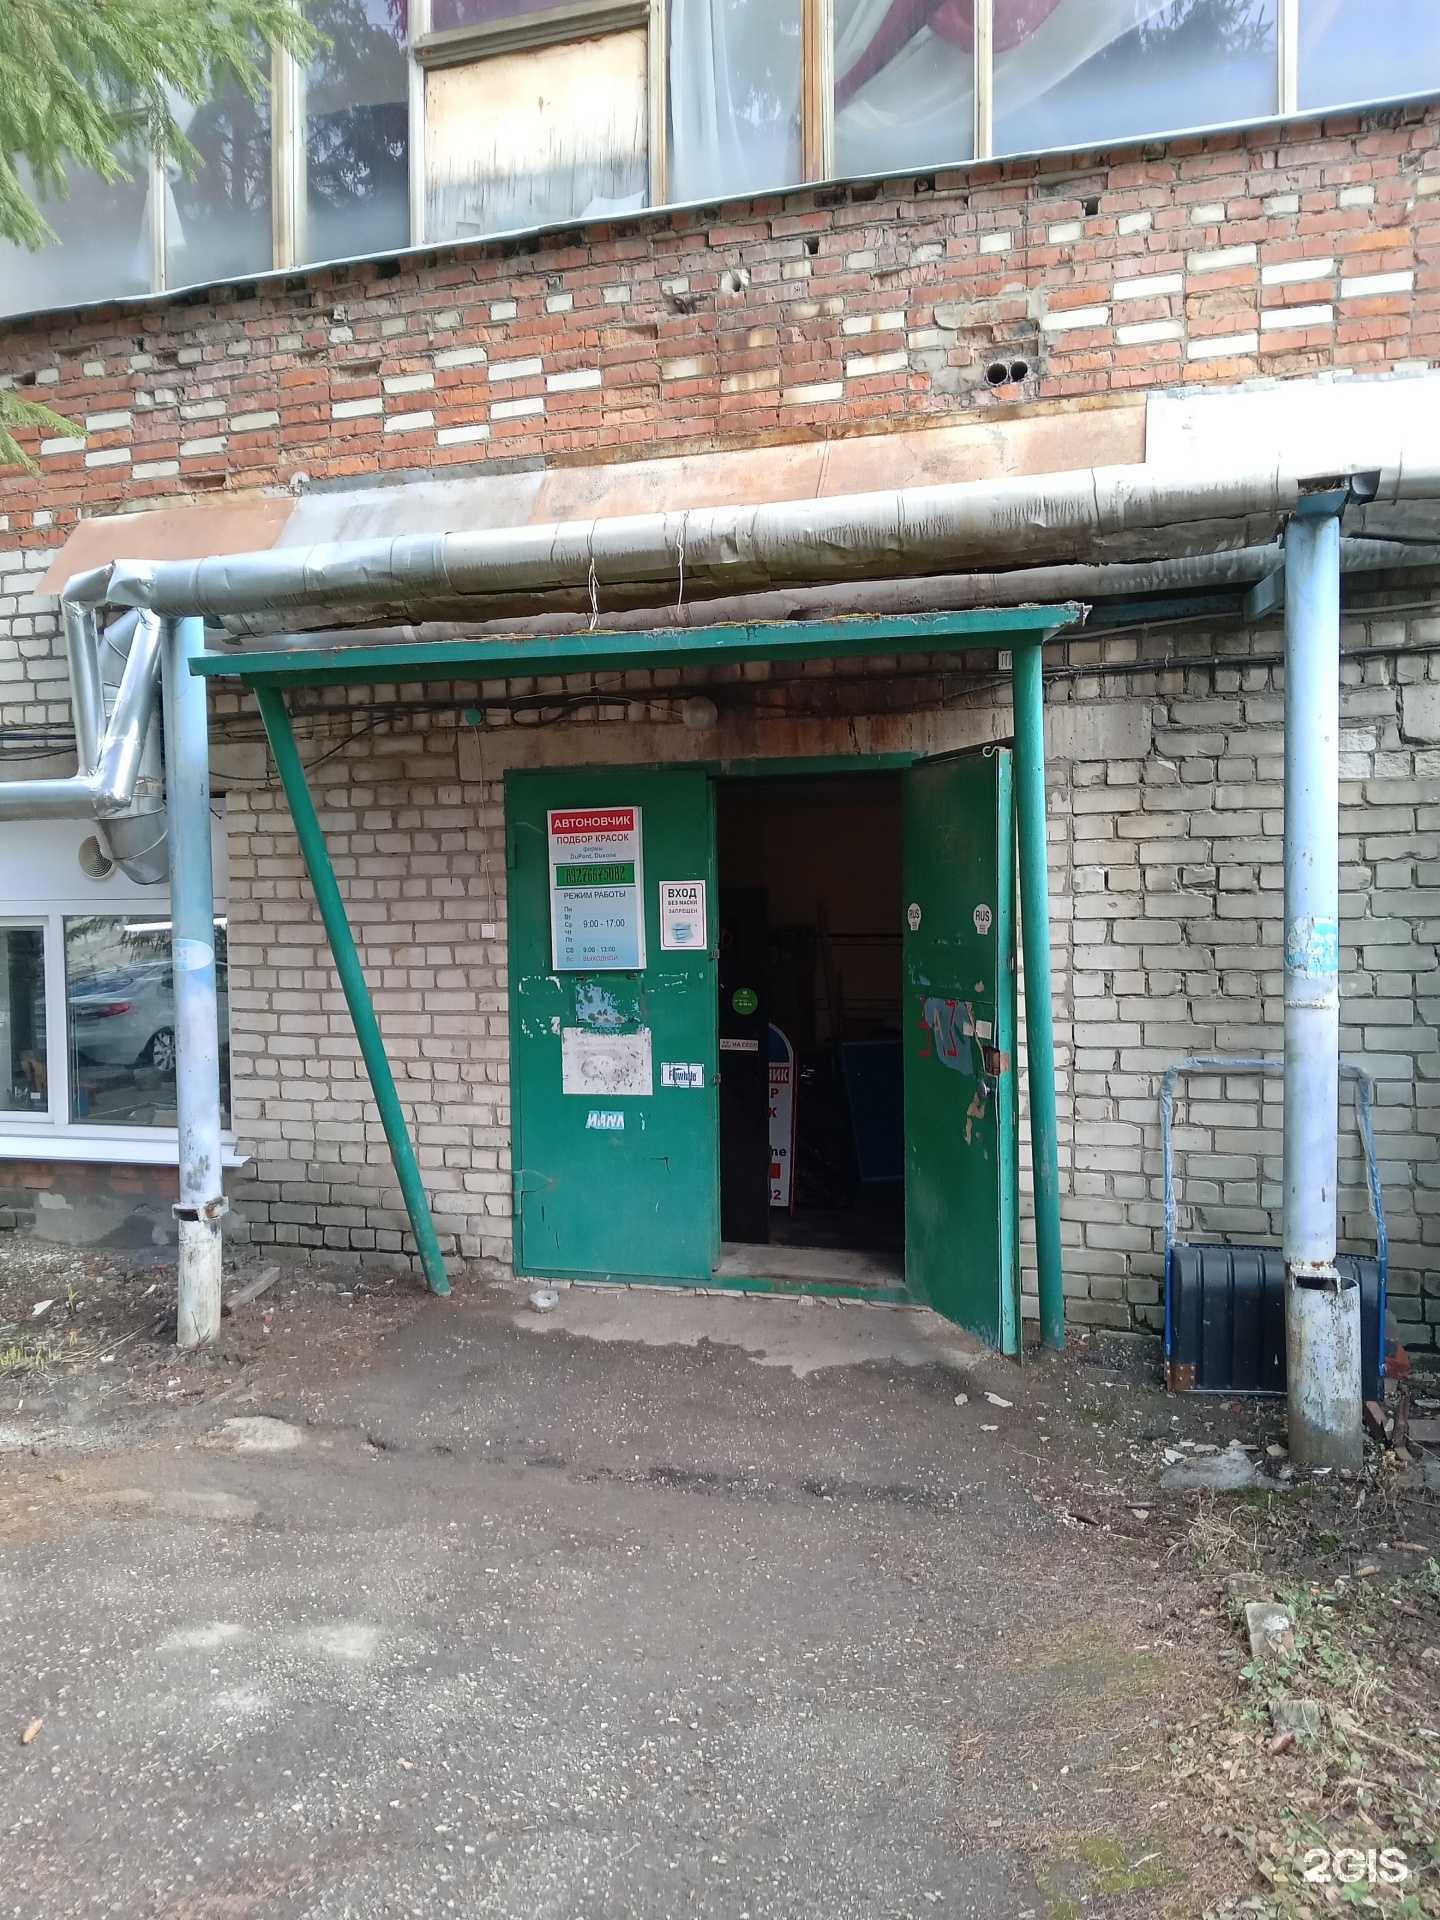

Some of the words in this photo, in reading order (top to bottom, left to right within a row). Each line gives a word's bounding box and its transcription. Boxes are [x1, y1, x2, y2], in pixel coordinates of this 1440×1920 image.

[554, 815, 631, 829] АВТОНОВЧИК
[556, 835, 593, 845] ПОДБОР
[595, 833, 629, 843] КРАСОК
[563, 891, 593, 900] РЕЖИМ
[594, 890, 626, 899] РАБОТЫ
[668, 888, 697, 899] ВХОД
[975, 910, 990, 922] RUS
